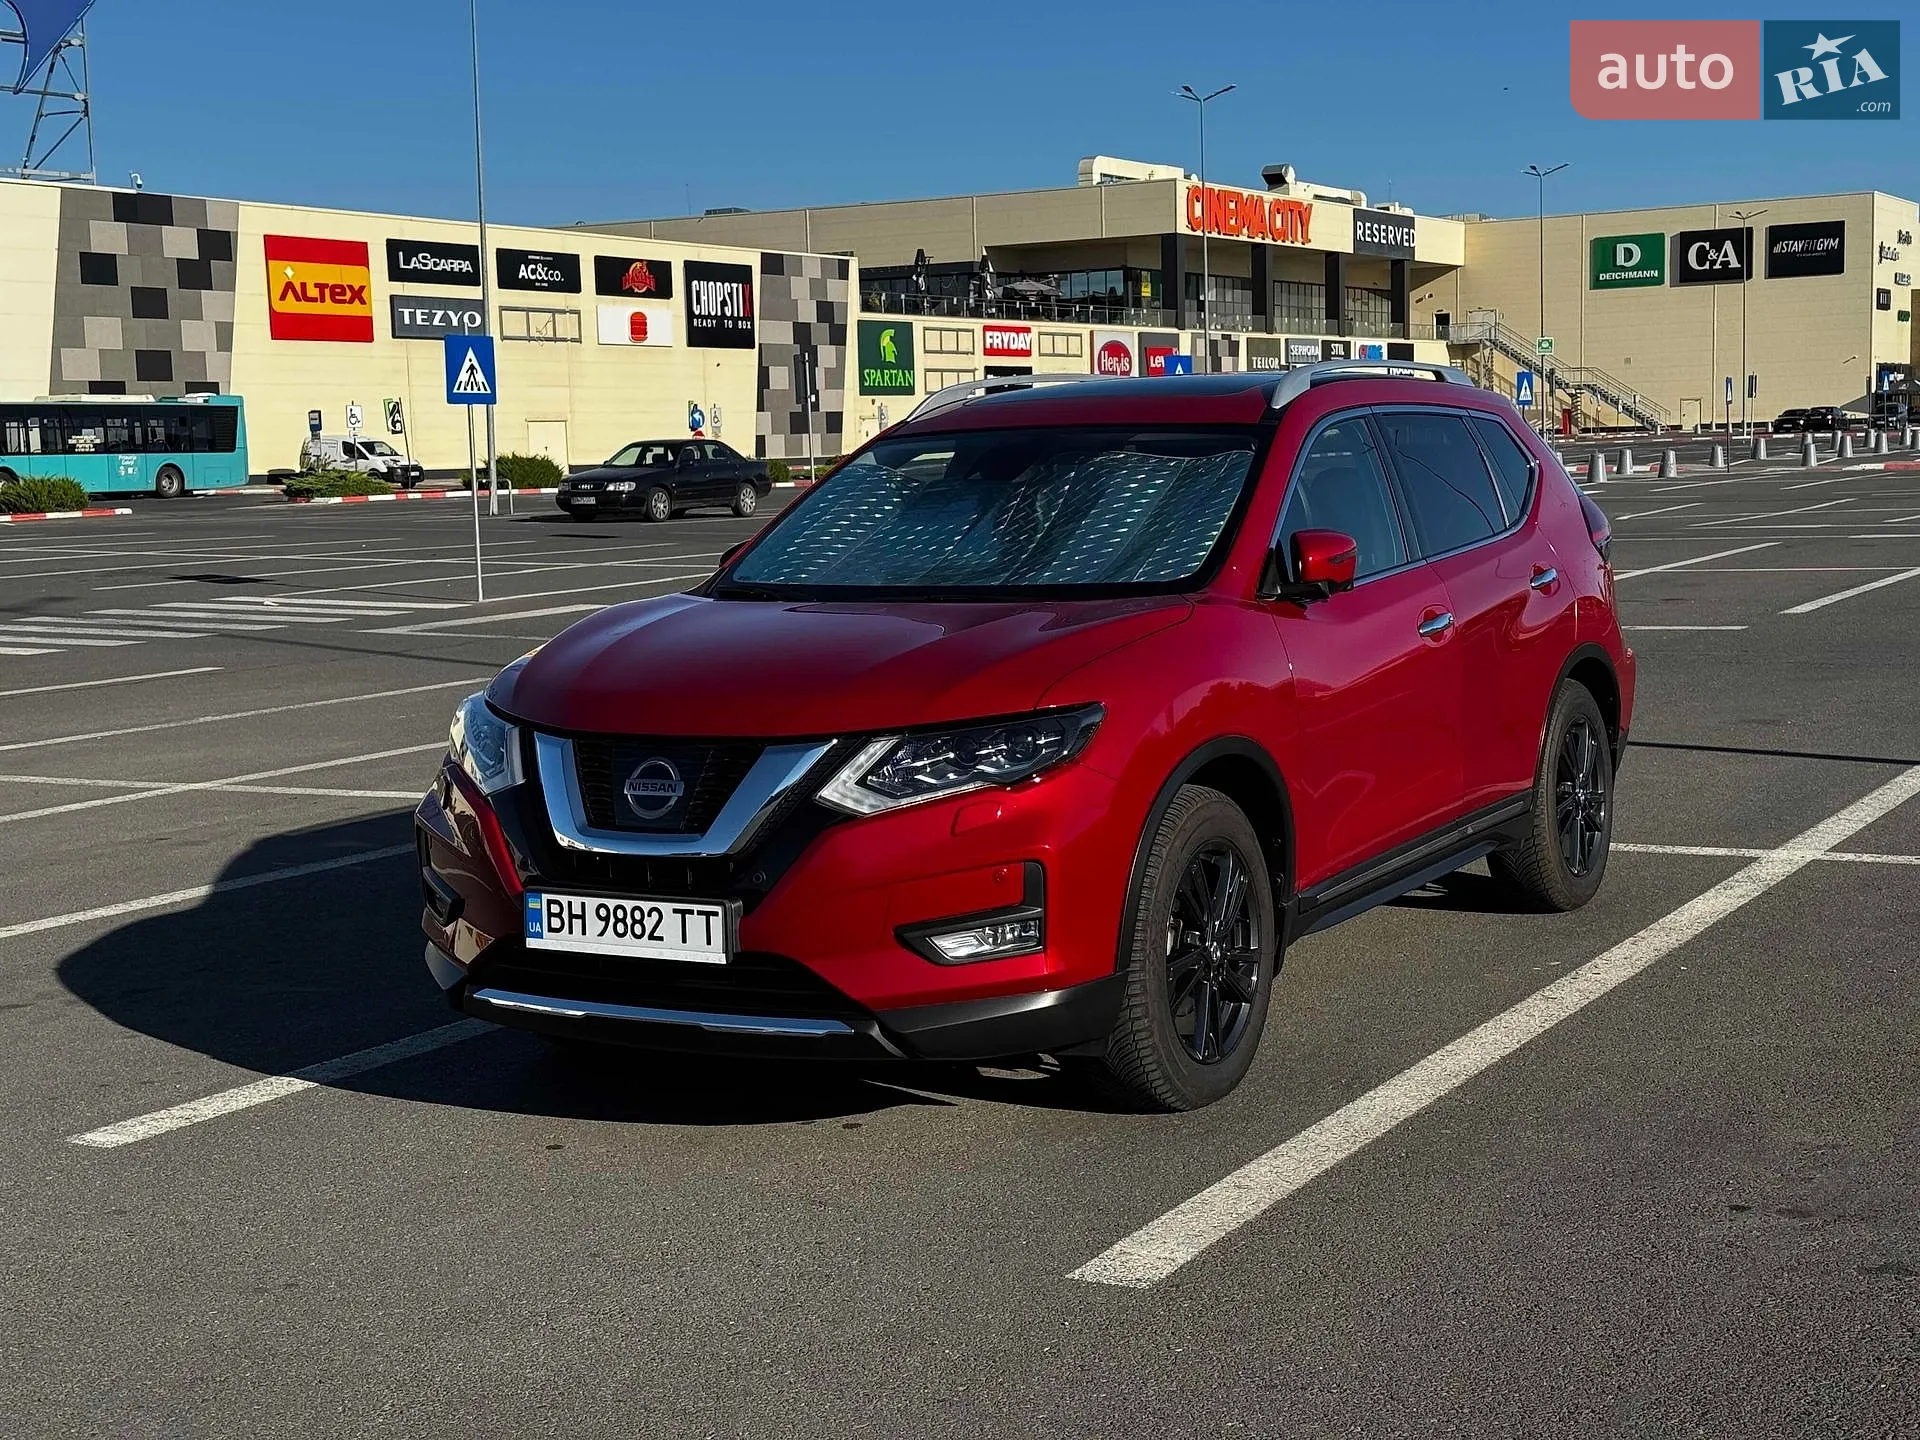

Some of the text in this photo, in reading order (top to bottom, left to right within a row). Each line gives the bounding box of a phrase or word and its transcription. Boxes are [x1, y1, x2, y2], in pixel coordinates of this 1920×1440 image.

[1187, 184, 1313, 246] CINEMA CITY
[1356, 221, 1416, 248] RESERVED
[1616, 242, 1641, 267] D
[1688, 240, 1741, 270] C&A
[1599, 269, 1659, 281] DEICHMANN
[691, 279, 751, 318] CHOPSTIX
[398, 308, 482, 328] TEZYO
[693, 318, 752, 330] READY TO BOX
[985, 331, 1032, 350] FRYDAY
[1290, 344, 1319, 356] SEPHORA
[1101, 350, 1130, 376] Hervis
[864, 368, 914, 388] SPARTAN
[628, 781, 677, 794] NISSAN
[529, 921, 541, 933] UA
[546, 898, 719, 946] BH 9882 TT
